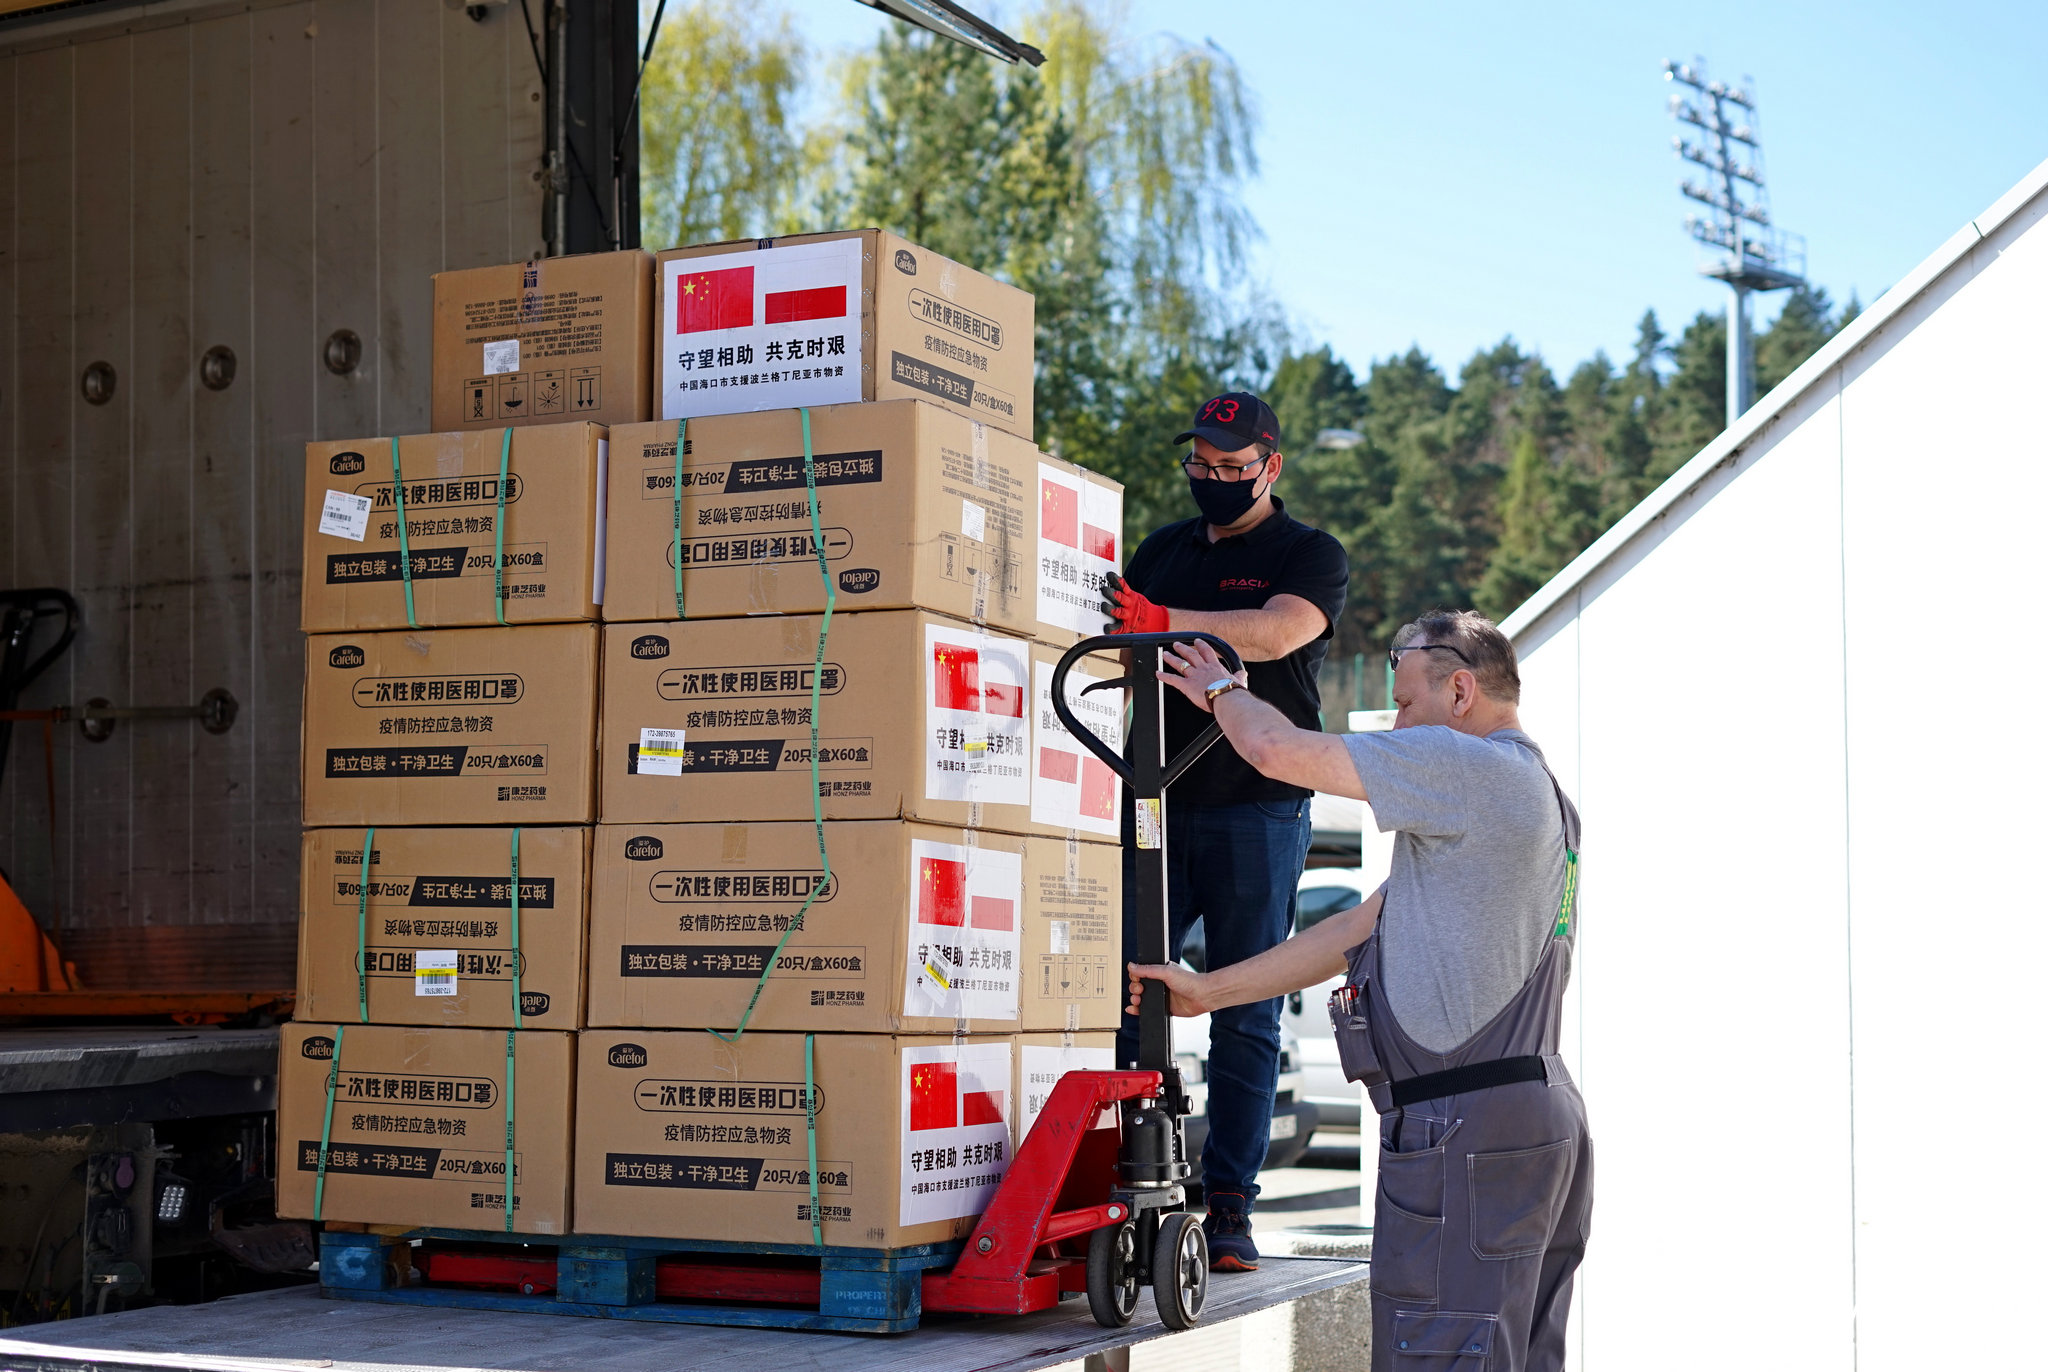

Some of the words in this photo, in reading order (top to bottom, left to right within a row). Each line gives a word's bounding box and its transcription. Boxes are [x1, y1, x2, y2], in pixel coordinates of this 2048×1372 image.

[895, 256, 916, 275] Carefor
[911, 297, 1001, 346] 一次性使用医用口罩
[678, 343, 754, 371] 守望相助
[765, 335, 846, 362] 共克时艰
[924, 334, 989, 373] 疫情防控应急物资
[679, 365, 844, 392] 中国海口市支援波兰格丁尼亚市物资
[973, 390, 1014, 417] 20只/盒X60盒
[1202, 399, 1240, 422] 93
[331, 459, 363, 473] Carefor
[646, 471, 725, 490] 20只/盒60盒
[841, 572, 878, 585] Carefor
[1042, 557, 1077, 584] 守望相助
[1082, 569, 1109, 592] 共克时
[331, 652, 364, 666] Carefor
[632, 643, 668, 657] Carefor
[358, 679, 518, 702] 一次性使用医用口罩
[662, 668, 838, 695] 一次性使用医用口罩
[379, 716, 493, 735] 疫情防控应急物资
[686, 707, 813, 728] 疫情防控应急物资
[986, 732, 1023, 756] 共克时艰
[467, 754, 544, 769] 20只/盒X60盒
[832, 781, 872, 791] 康芝药业
[627, 844, 662, 858] Carefor
[337, 882, 409, 897] 20只/盒60盒
[655, 876, 831, 897] 一次性使用医用口罩
[384, 919, 498, 937] 疫情防控应急物资
[679, 914, 805, 932] 疫情防控应急物资
[776, 956, 862, 971] 20只/盒X60盒
[918, 943, 963, 967] 守相助
[969, 947, 1012, 970] 共克时艰
[825, 991, 865, 1001] 康芝药业
[303, 1044, 335, 1058] Carefo
[610, 1052, 646, 1065] Carefor
[335, 1077, 491, 1104] 一次性使用医用口罩
[640, 1085, 817, 1110] 一次性使用医用口罩
[351, 1114, 466, 1136] 疫情防控应急物资
[664, 1124, 792, 1145] 疫情防控应急物资
[911, 1146, 957, 1172] 守望相助
[963, 1141, 1003, 1166] 共克时艰
[763, 1169, 849, 1187] 20只/盒60盒
[485, 1193, 521, 1205] 康芝业
[818, 1206, 852, 1217] 芝药业
